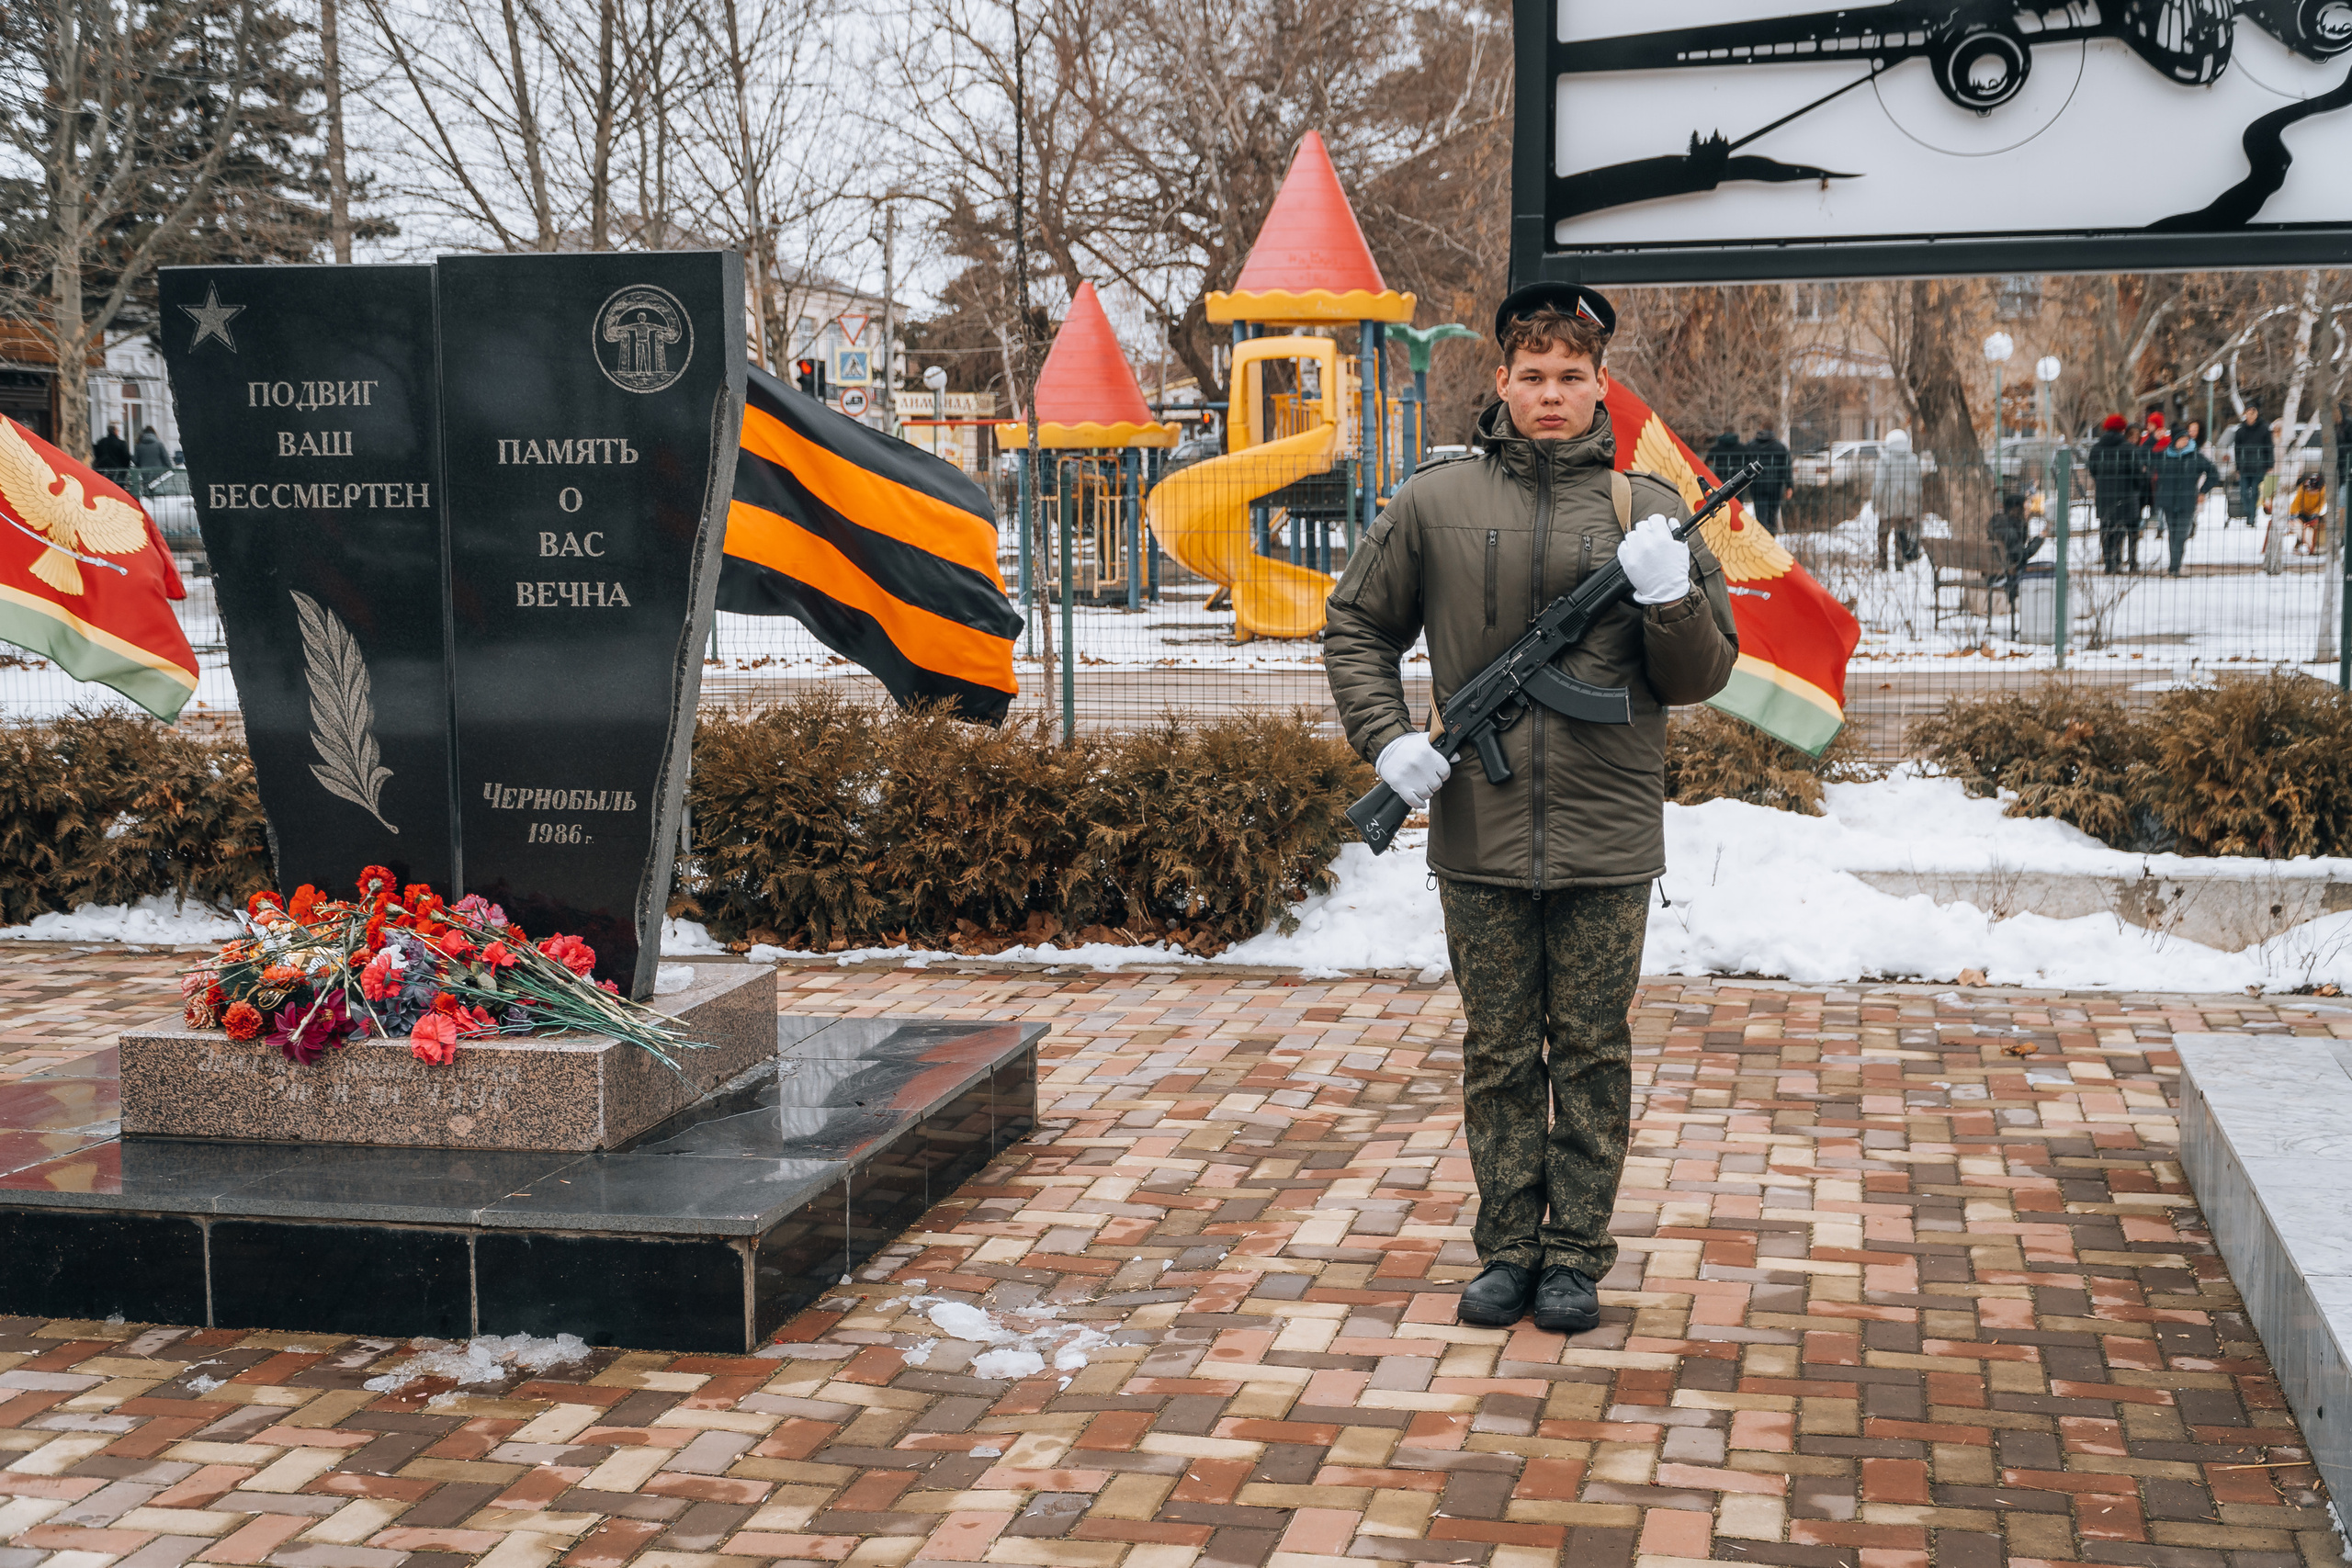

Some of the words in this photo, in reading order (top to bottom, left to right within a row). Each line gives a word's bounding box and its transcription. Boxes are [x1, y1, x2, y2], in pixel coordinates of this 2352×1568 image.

[247, 380, 379, 412] ПОДВИГ
[277, 431, 354, 457] ВАШ
[498, 438, 639, 465] ПАМЯТЬ
[209, 482, 431, 509] БЕССМЕРТЕН
[559, 487, 583, 513] О
[538, 531, 605, 558] ВАС
[516, 581, 632, 607] ВЕЧНА
